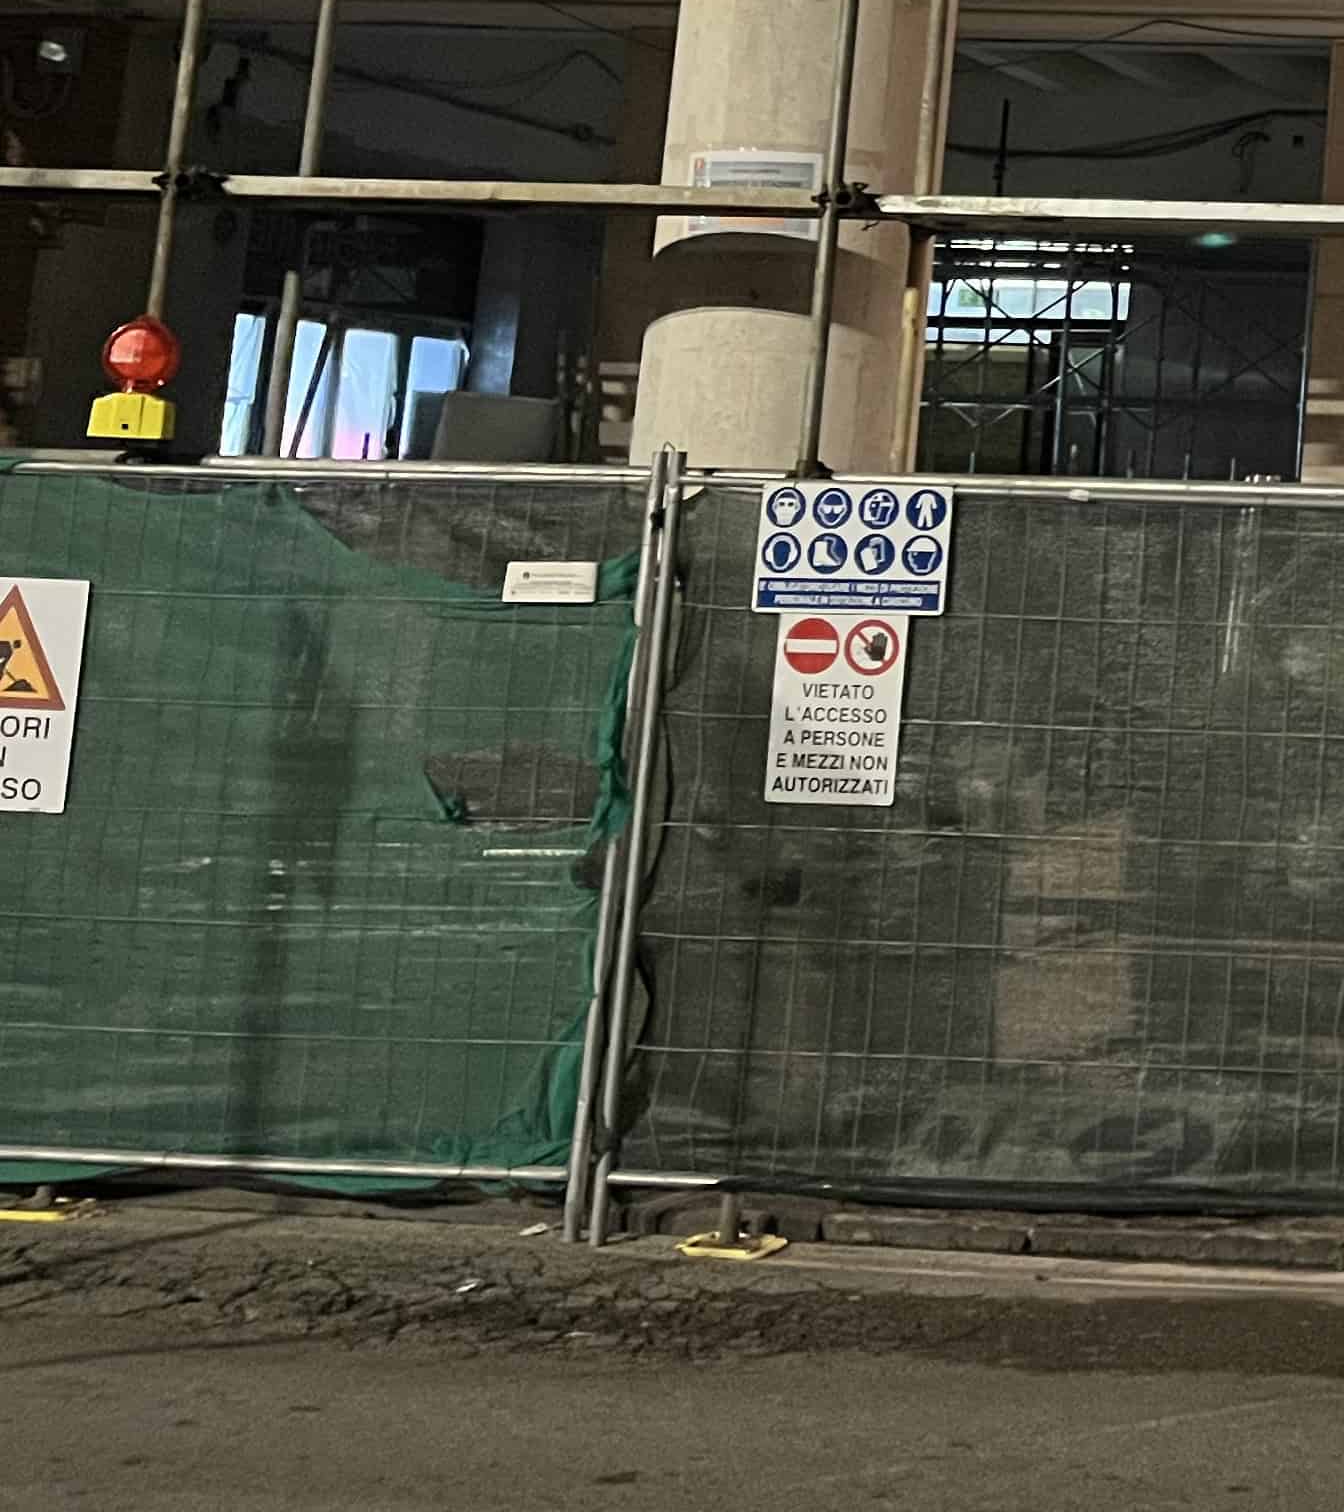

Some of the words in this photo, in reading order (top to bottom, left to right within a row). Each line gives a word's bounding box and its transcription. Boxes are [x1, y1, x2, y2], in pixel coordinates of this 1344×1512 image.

[802, 683, 875, 700] VIETATO
[784, 705, 888, 724] L'ACCESSO
[783, 729, 795, 745] A
[800, 730, 885, 747] PERSONE
[776, 753, 787, 768] E
[791, 753, 845, 769] MEZZI
[849, 755, 888, 771] NON
[772, 776, 889, 795] AUTORIZZATI
